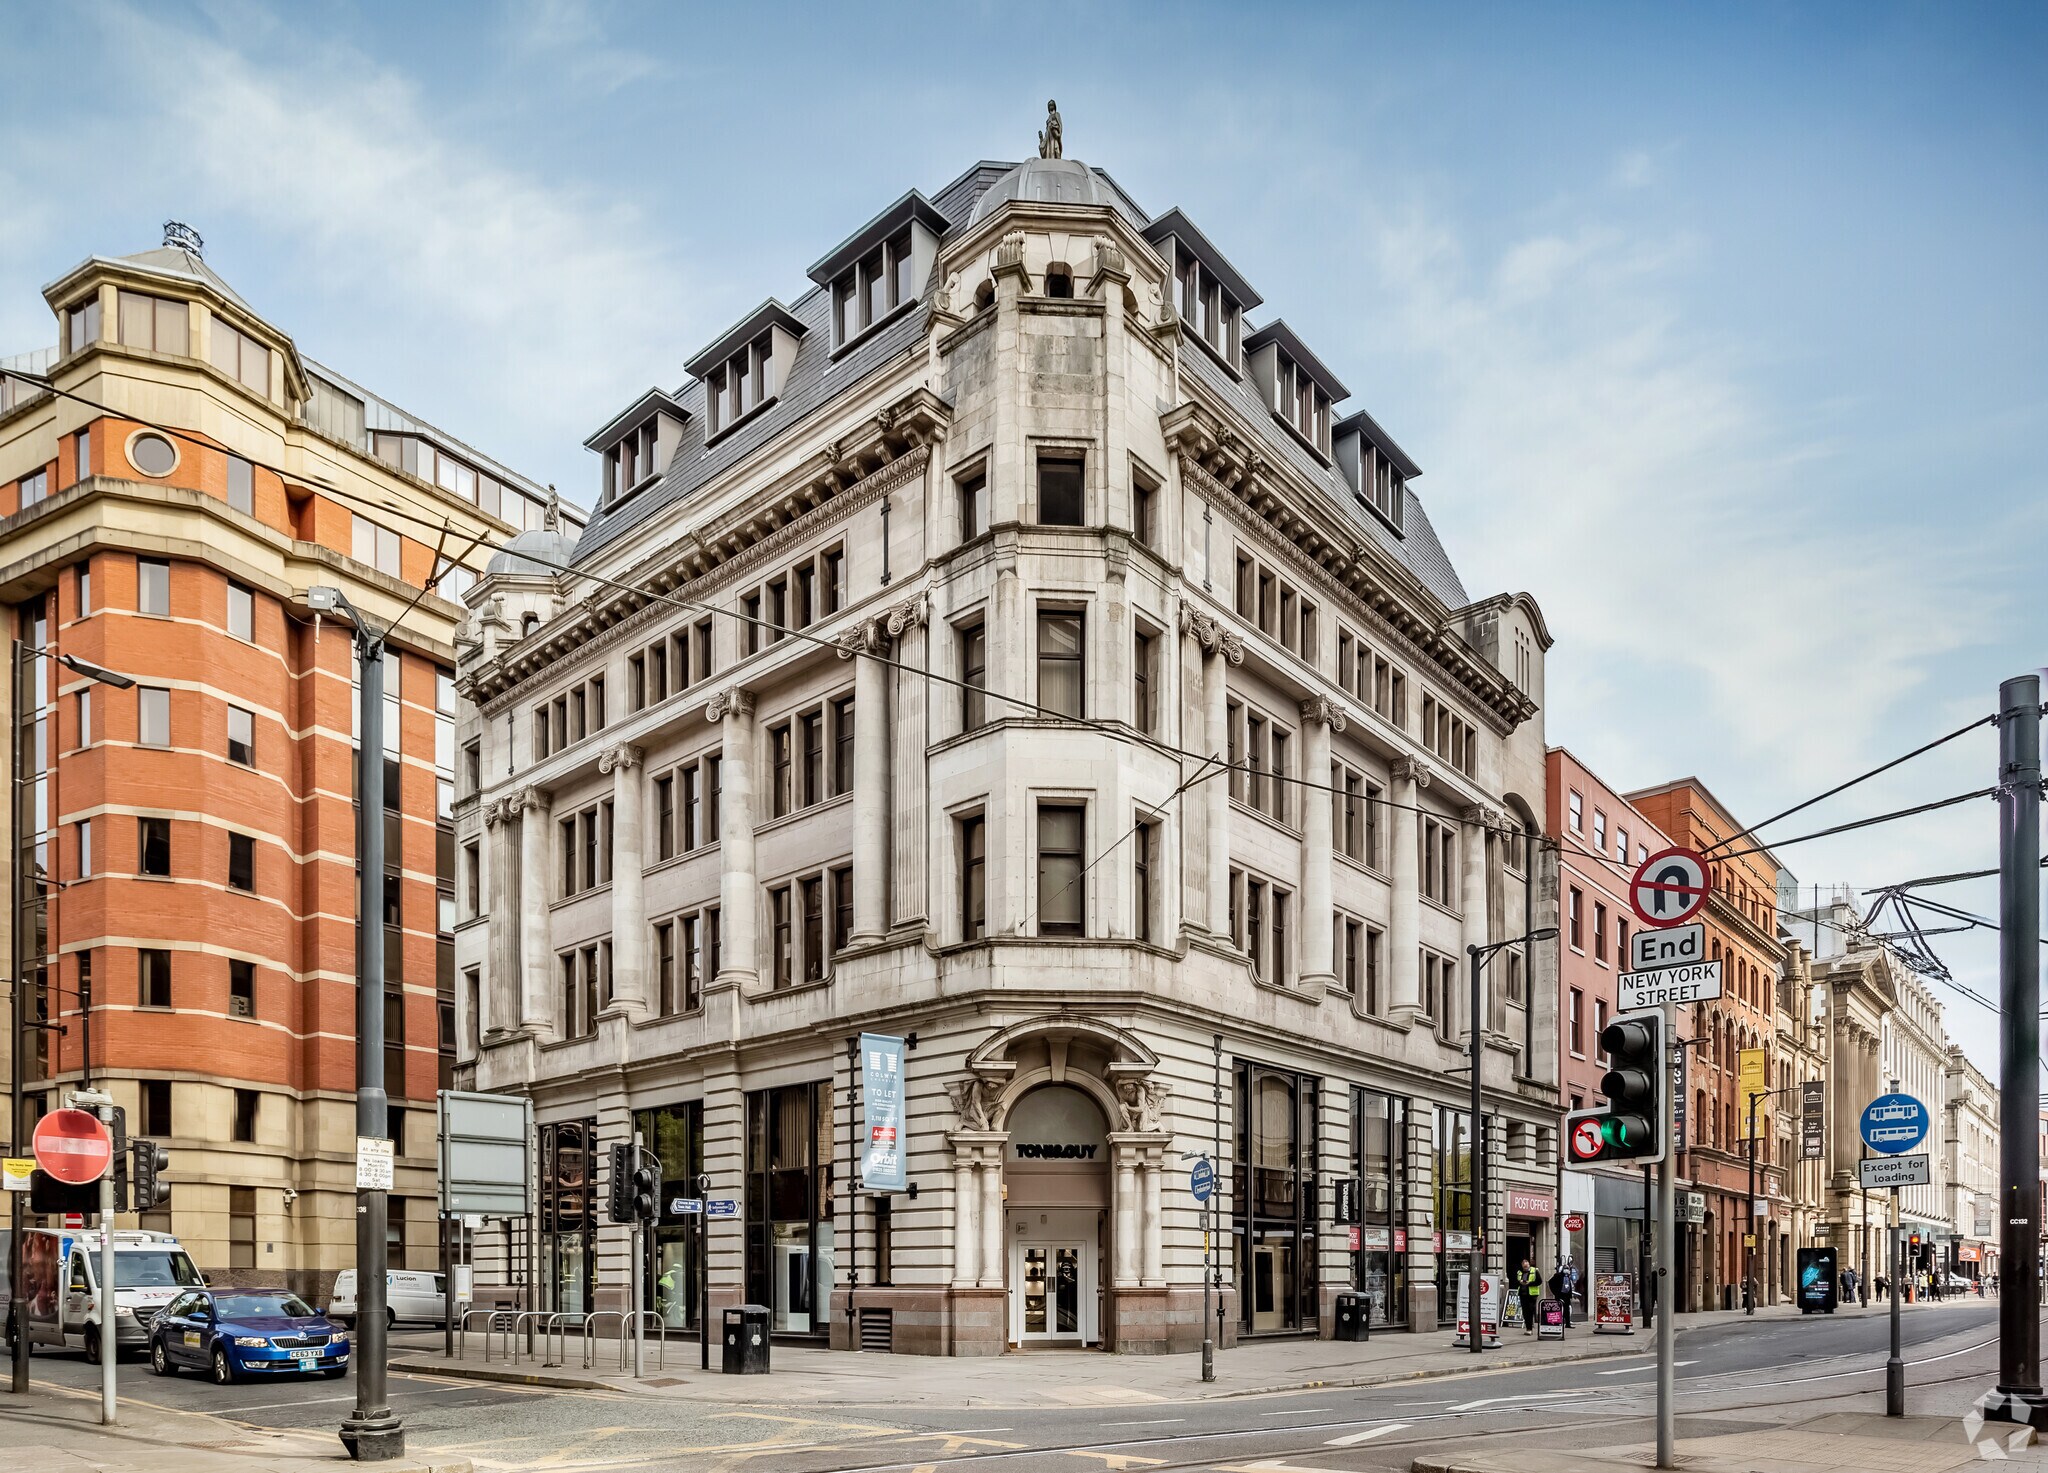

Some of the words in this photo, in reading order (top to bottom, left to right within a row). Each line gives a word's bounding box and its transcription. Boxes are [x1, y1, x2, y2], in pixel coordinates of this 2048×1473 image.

[1641, 931, 1696, 962] End
[1623, 971, 1663, 991] NEW
[1668, 964, 1716, 984] YORK
[1636, 984, 1701, 1006] STREET
[871, 1088, 882, 1097] TO
[884, 1089, 897, 1099] LET
[870, 1153, 897, 1165] Orbit
[1863, 1161, 1903, 1173] Except
[1908, 1160, 1924, 1170] for
[1874, 1173, 1915, 1183] loading
[1514, 1196, 1529, 1210] POST
[1529, 1199, 1549, 1212] OFFICE
